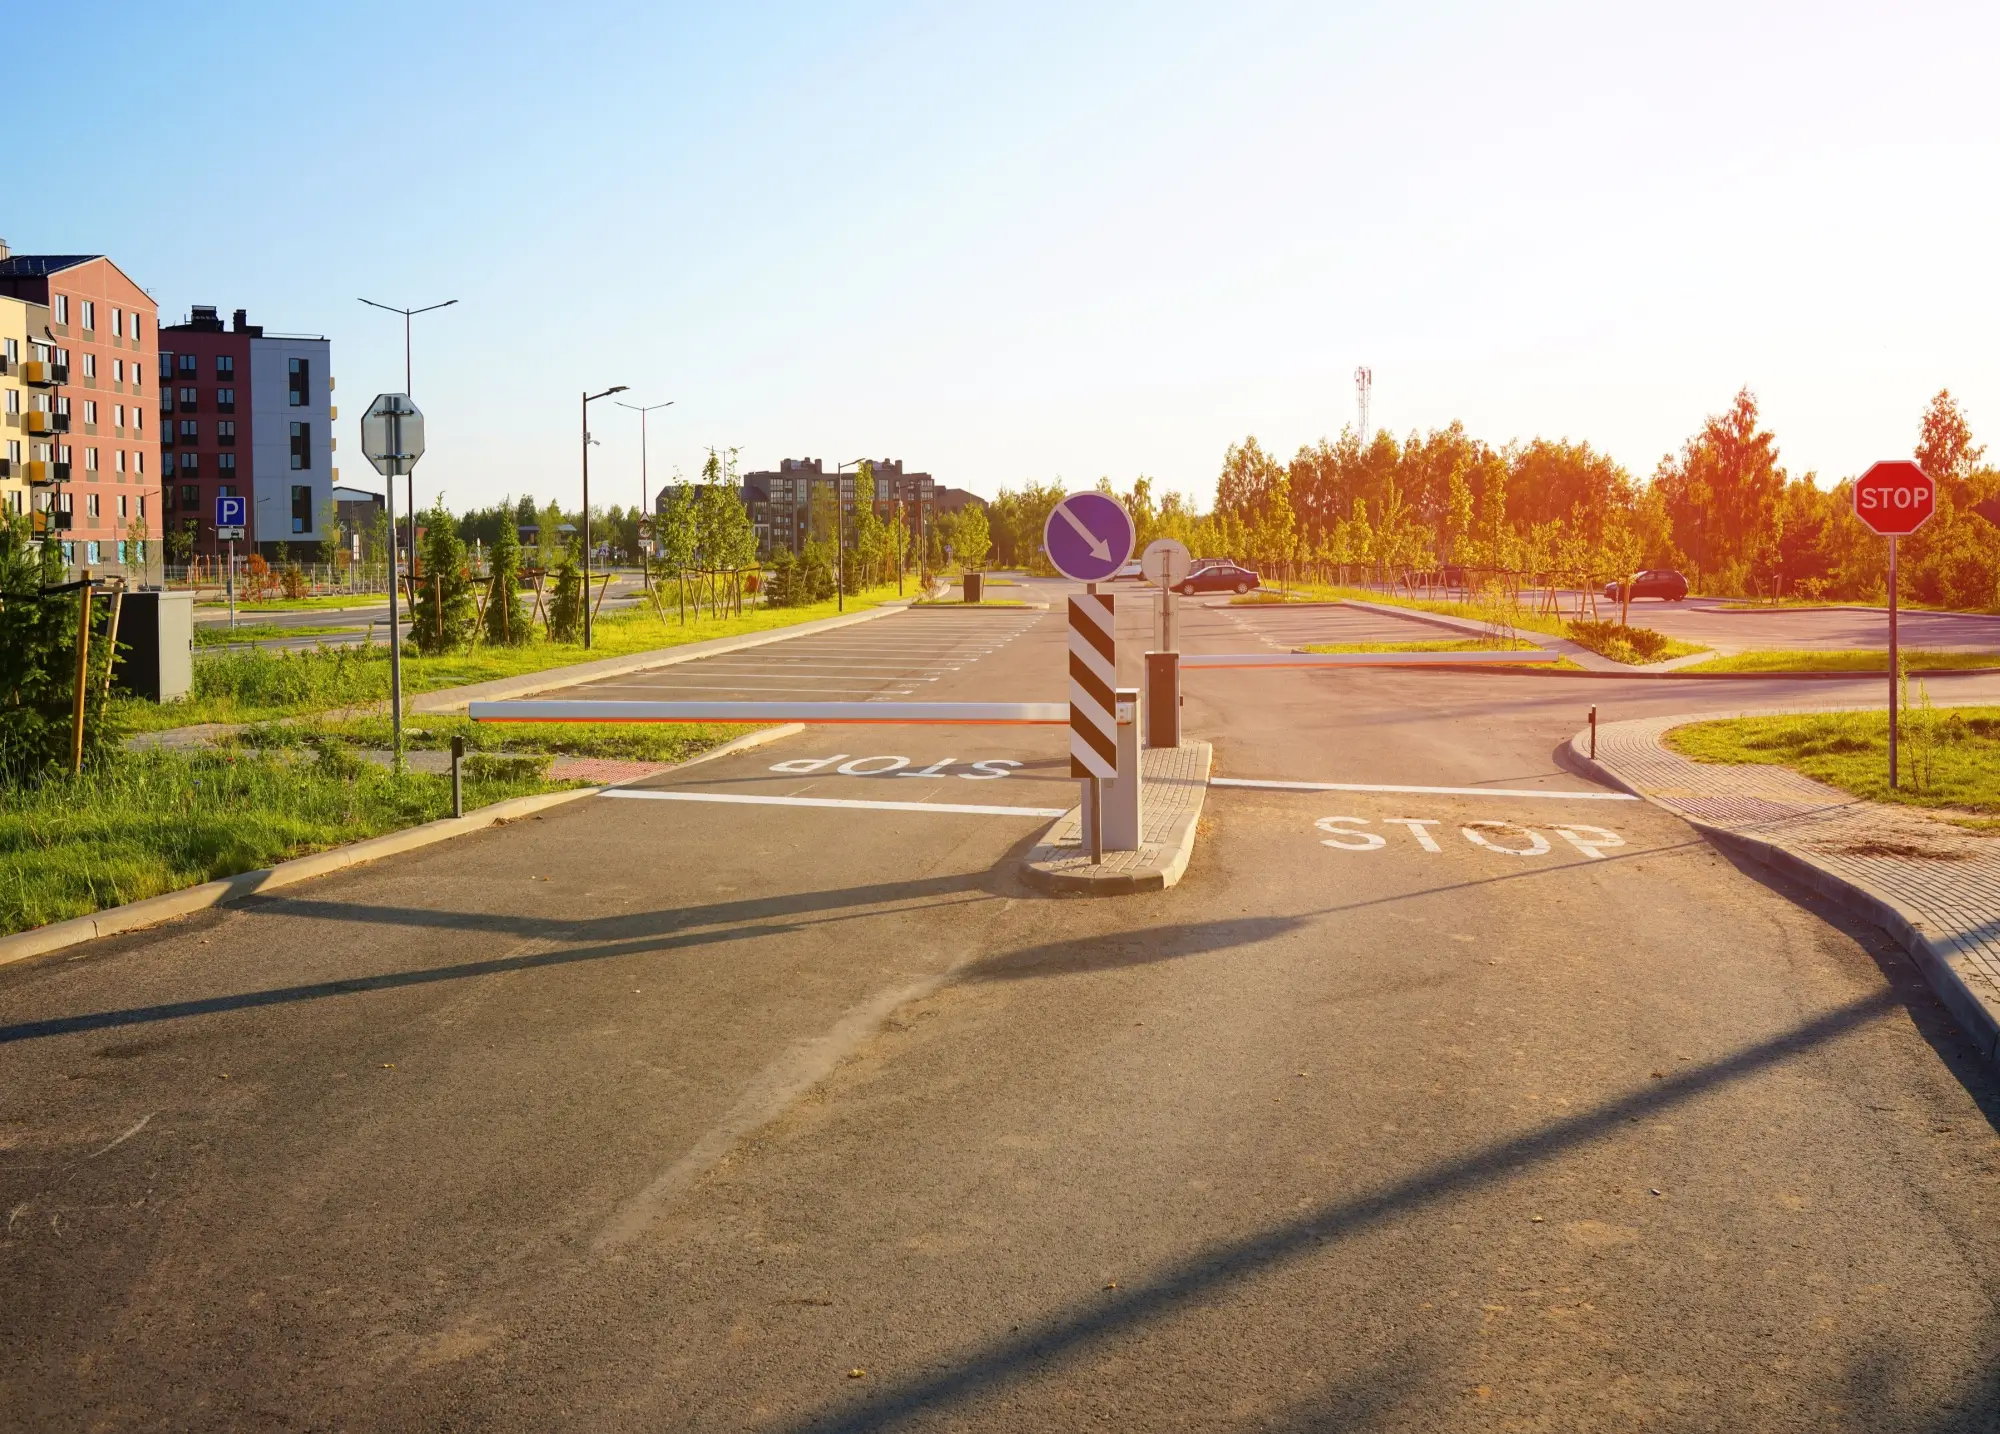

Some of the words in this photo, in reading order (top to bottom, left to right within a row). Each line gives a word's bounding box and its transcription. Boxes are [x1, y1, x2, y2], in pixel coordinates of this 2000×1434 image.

[1861, 487, 1929, 509] STOP
[223, 500, 239, 523] P
[768, 754, 1024, 780] STOP
[1313, 816, 1627, 859] STOP
